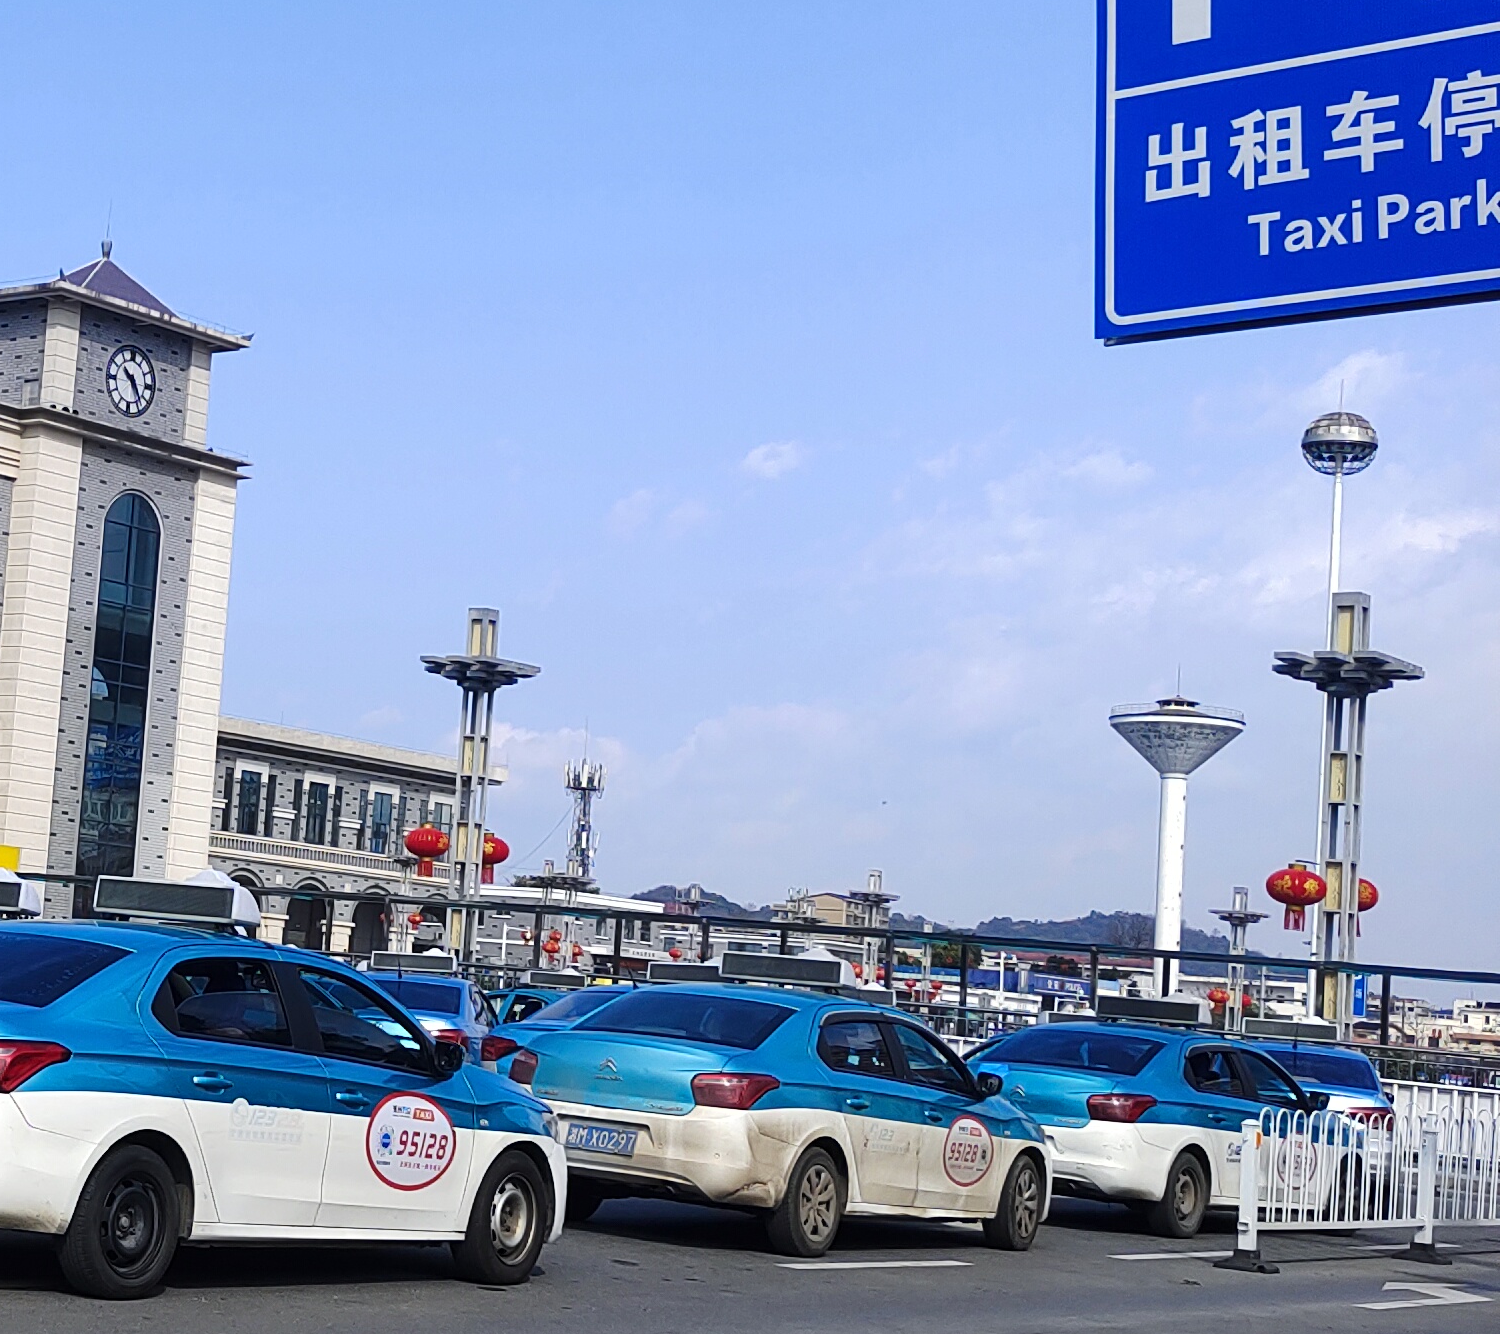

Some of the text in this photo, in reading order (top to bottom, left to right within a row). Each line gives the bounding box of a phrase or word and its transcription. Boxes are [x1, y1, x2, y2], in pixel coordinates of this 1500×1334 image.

[1145, 69, 1500, 203] 出租车停
[1248, 179, 1500, 256] Taxi Park
[396, 1129, 449, 1161] 95128
[947, 1142, 979, 1163] 95128
